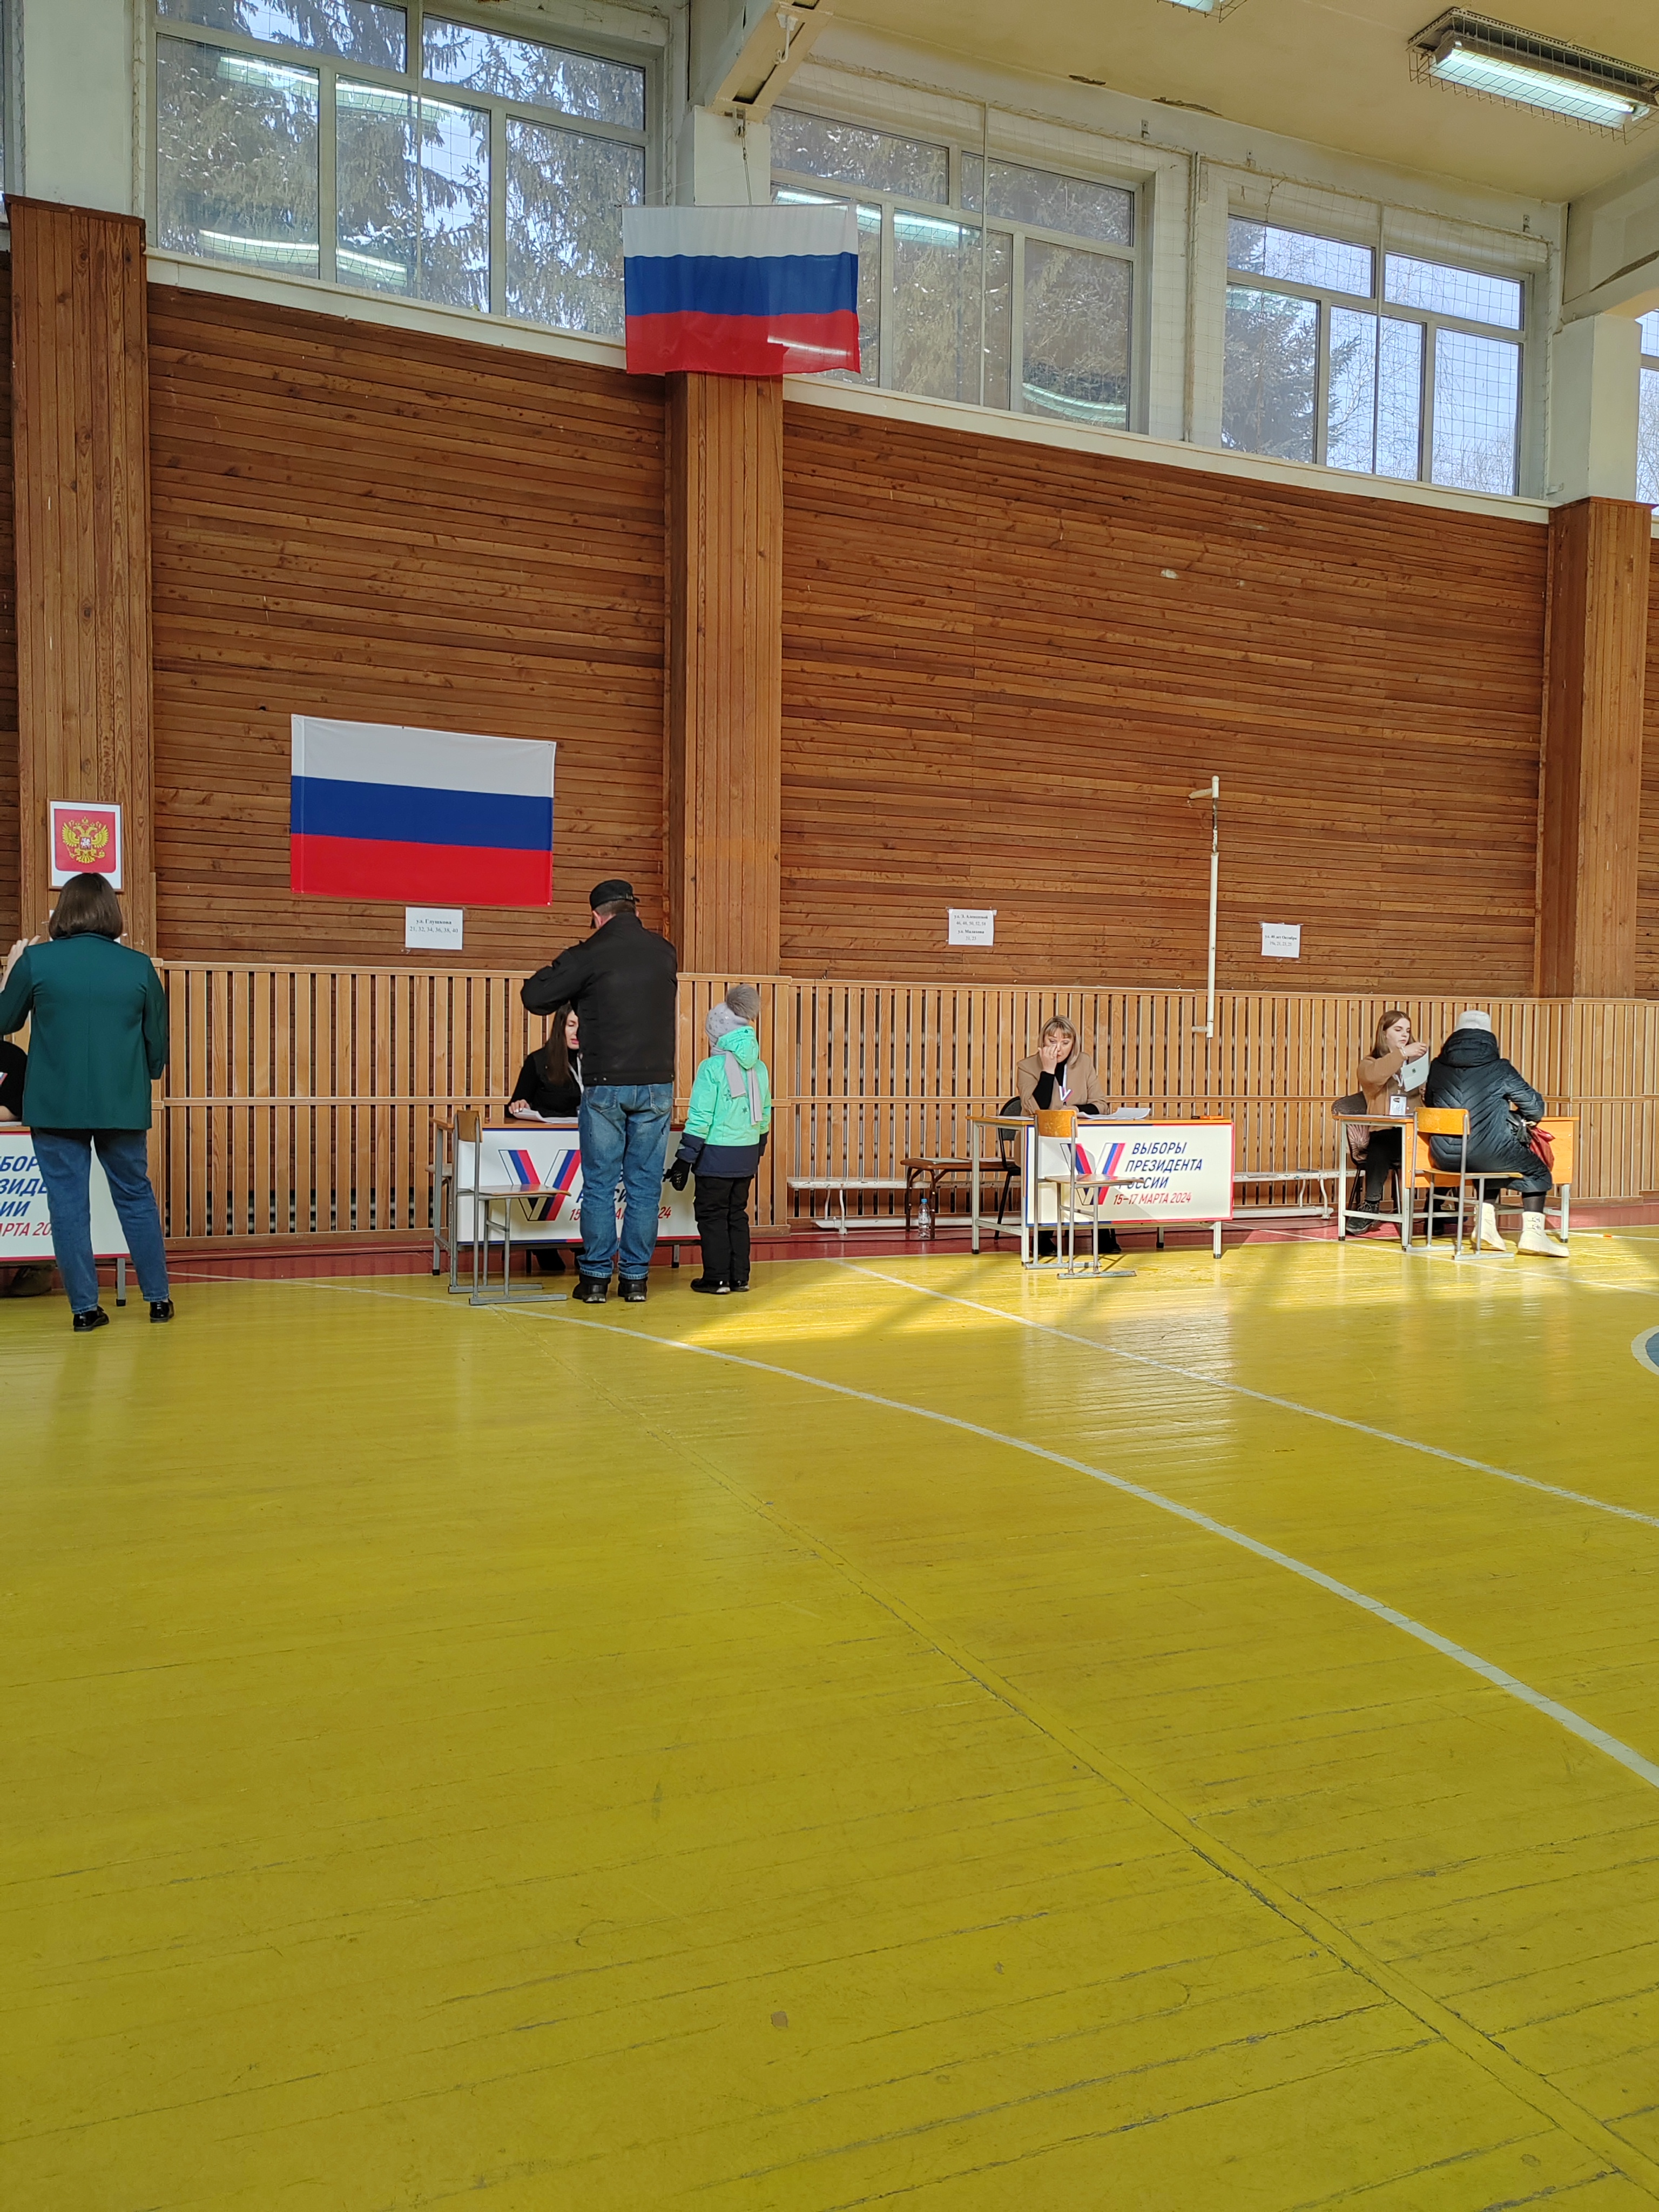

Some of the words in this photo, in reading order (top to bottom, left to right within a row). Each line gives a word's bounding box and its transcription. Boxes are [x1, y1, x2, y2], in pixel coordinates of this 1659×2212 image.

[1132, 1142, 1188, 1155] ВЫБОРЫ
[1124, 1158, 1203, 1173] ПРЕЗИДЕНТА
[1118, 1176, 1169, 1190] ОССИИ
[1138, 1192, 1169, 1204] МАРТА
[1170, 1192, 1191, 1203] 2024
